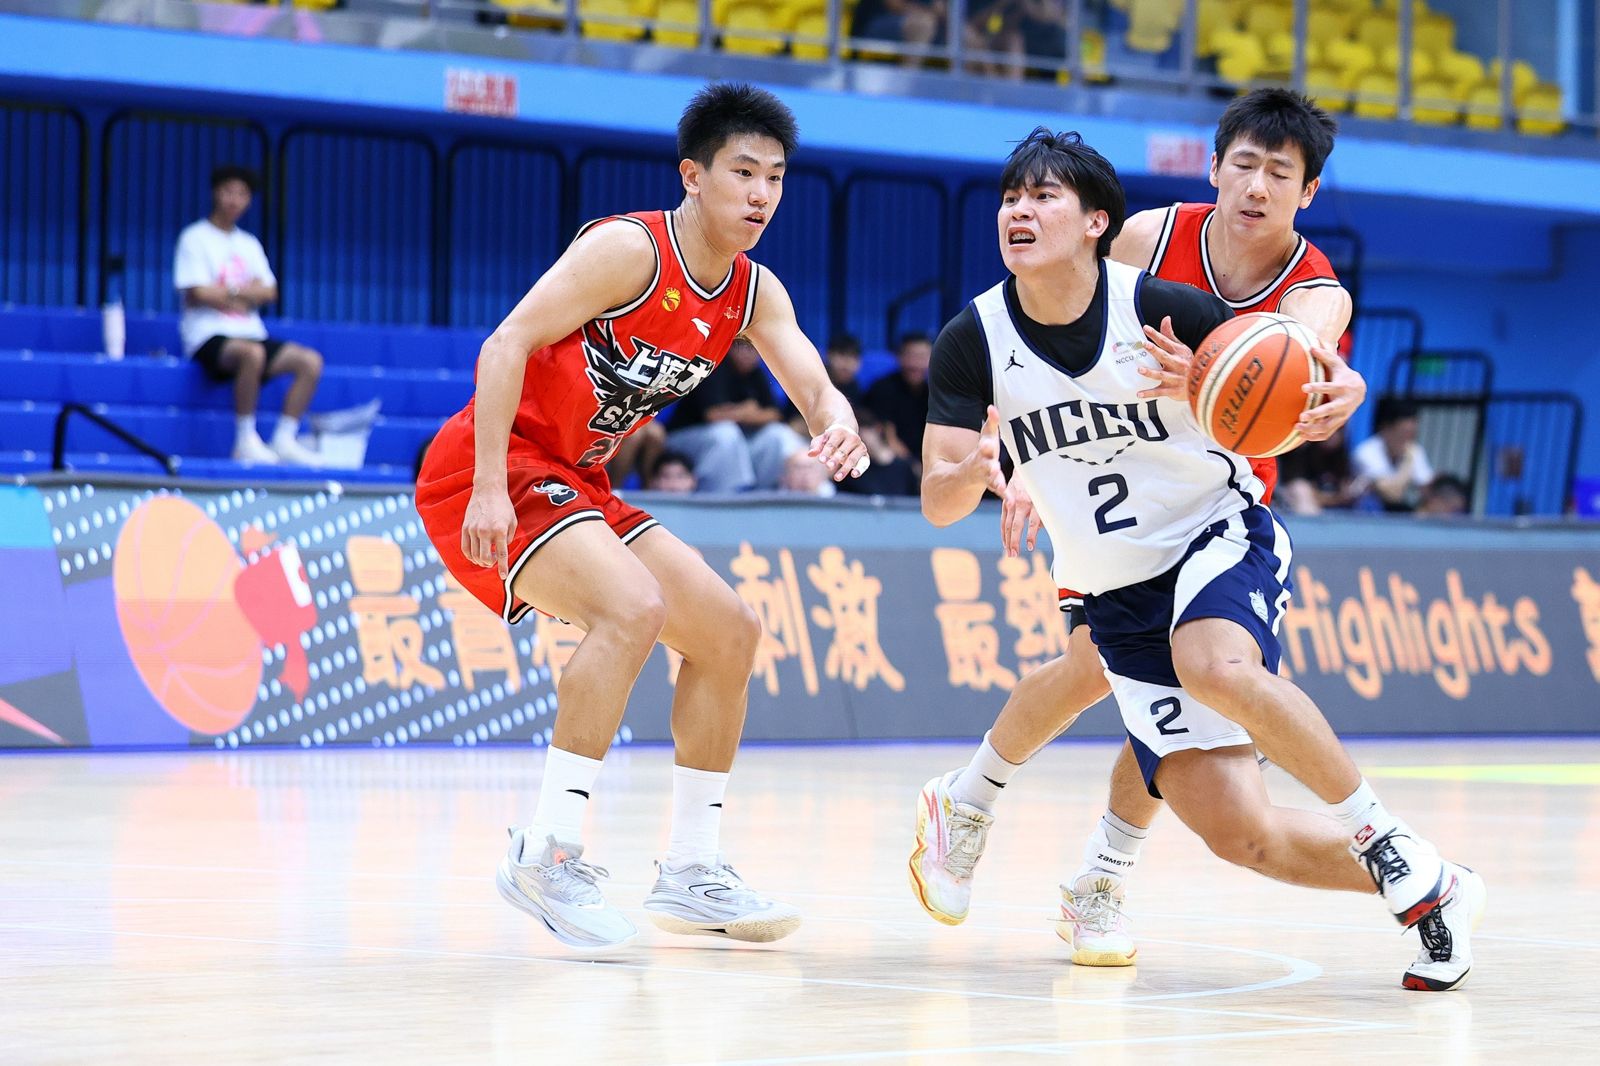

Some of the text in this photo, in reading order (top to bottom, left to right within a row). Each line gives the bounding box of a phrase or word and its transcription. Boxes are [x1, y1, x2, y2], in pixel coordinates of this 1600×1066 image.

[1115, 355, 1134, 365] NCCU
[1009, 399, 1170, 465] NCCU
[1088, 473, 1137, 534] 2
[664, 540, 905, 697] 刺激
[1284, 565, 1552, 699] Highlights
[1150, 696, 1189, 735] 2
